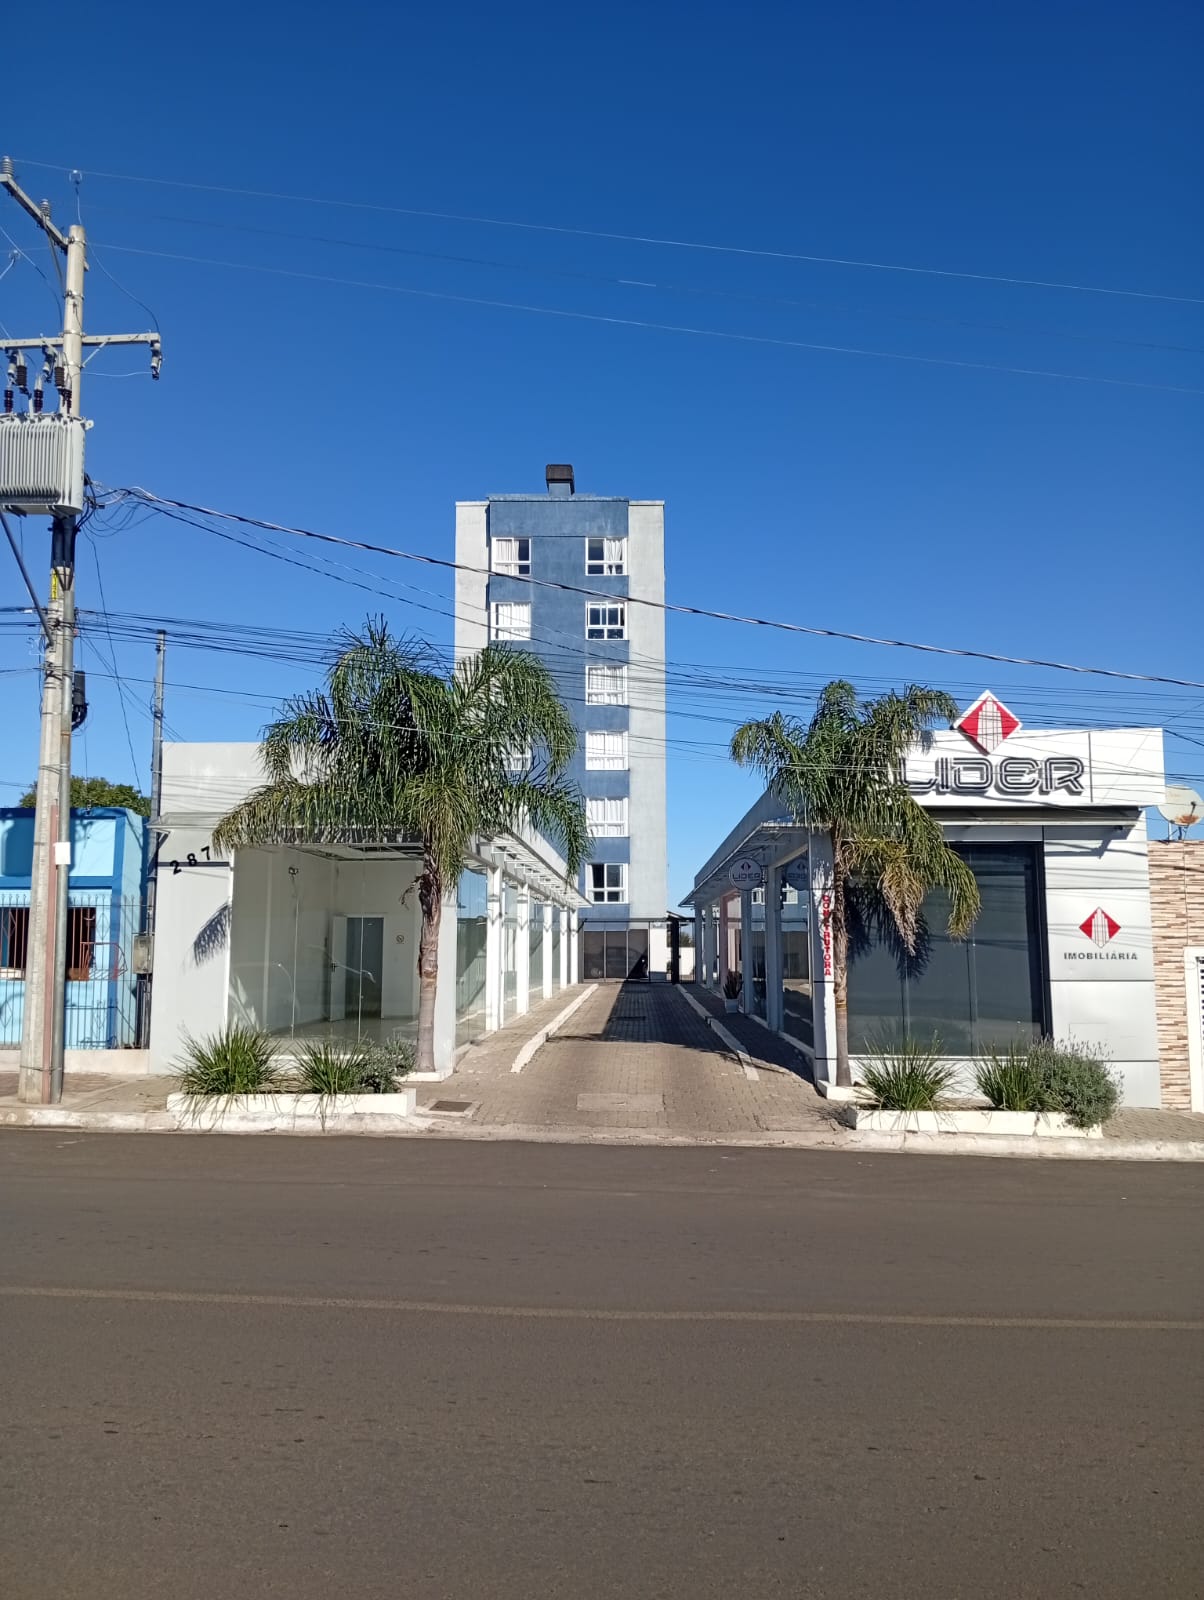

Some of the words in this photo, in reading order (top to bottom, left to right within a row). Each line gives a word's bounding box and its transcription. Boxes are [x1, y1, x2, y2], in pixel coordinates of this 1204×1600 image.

[900, 757, 1085, 790] LIDER
[170, 846, 210, 875] 287
[822, 895, 832, 976] CONTRUTORA
[1063, 950, 1138, 960] IMOBILIÁRIA
